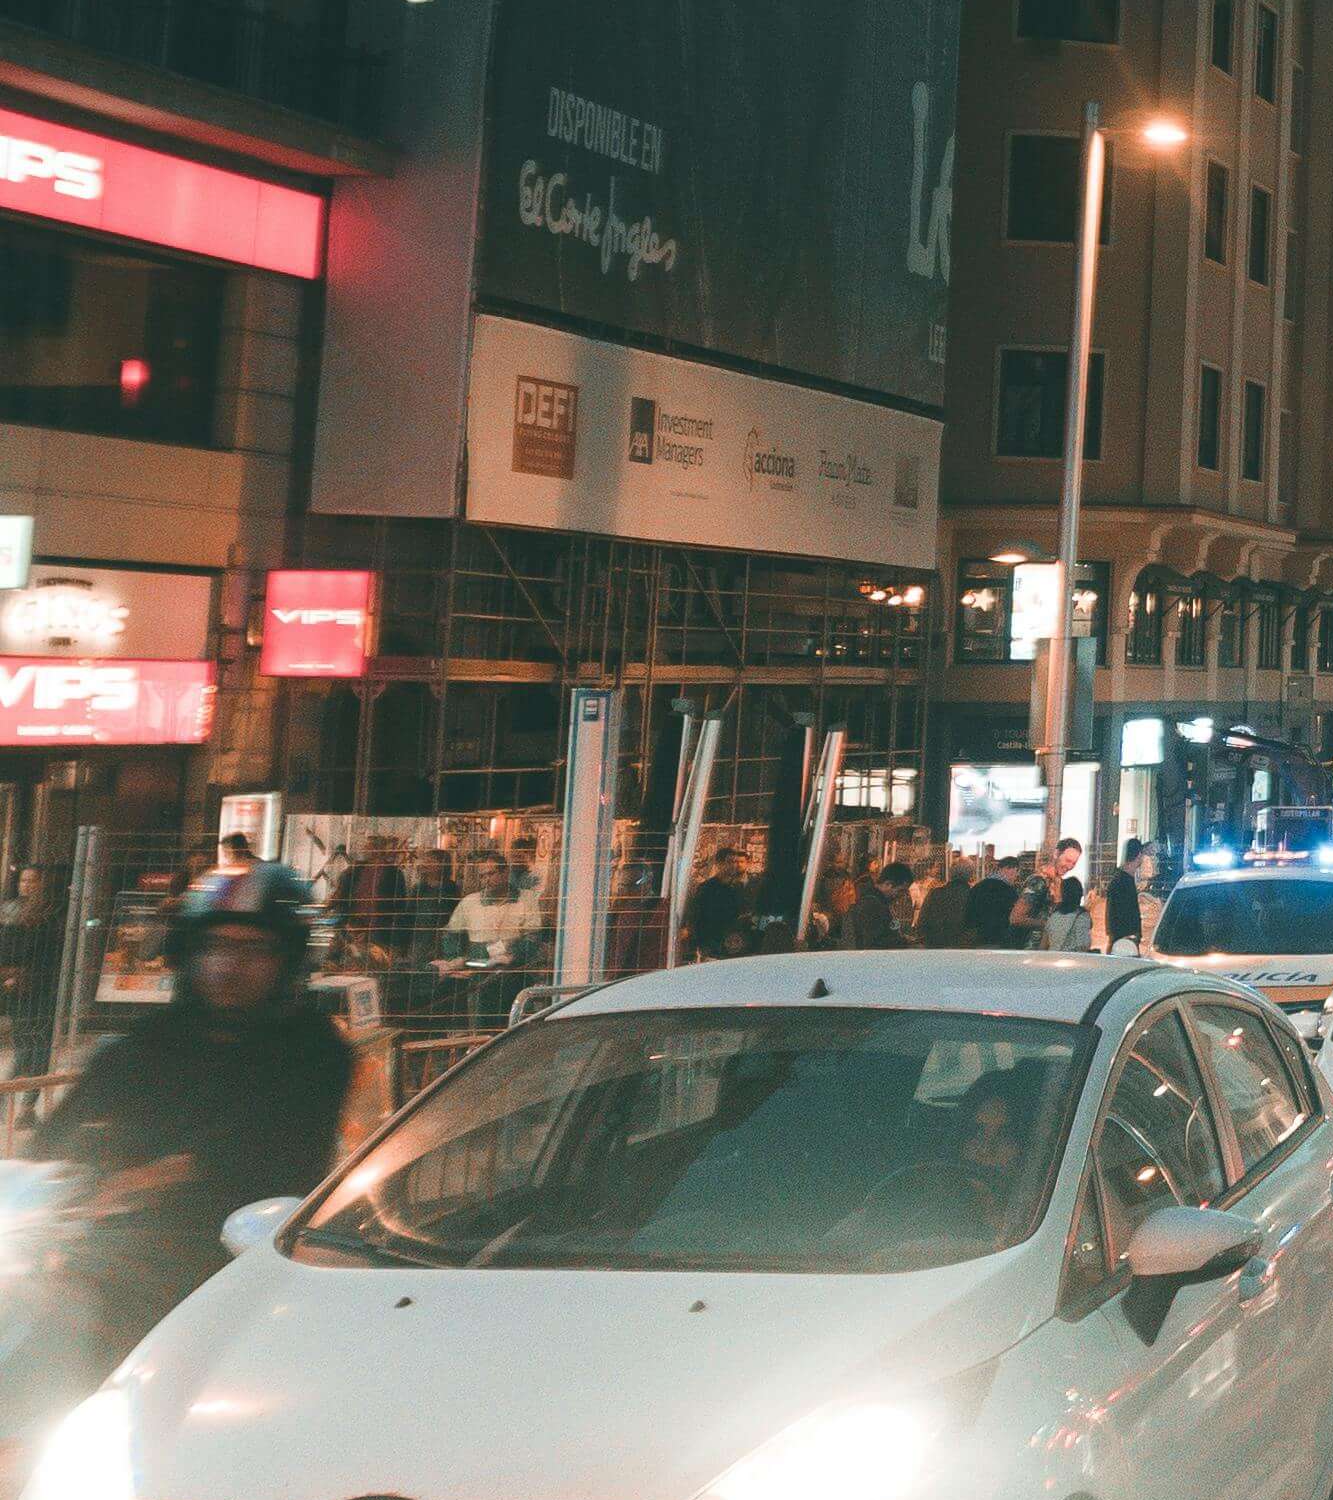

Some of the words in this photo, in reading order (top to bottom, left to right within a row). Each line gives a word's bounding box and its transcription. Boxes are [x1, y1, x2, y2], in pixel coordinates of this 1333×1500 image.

[546, 86, 640, 166] DISPONIBLE
[641, 122, 665, 174] EN
[656, 406, 714, 441] Investment
[655, 436, 704, 470] Managers
[754, 448, 796, 479] acciona
[271, 607, 365, 626] VIPS
[0, 665, 139, 711] VIPS
